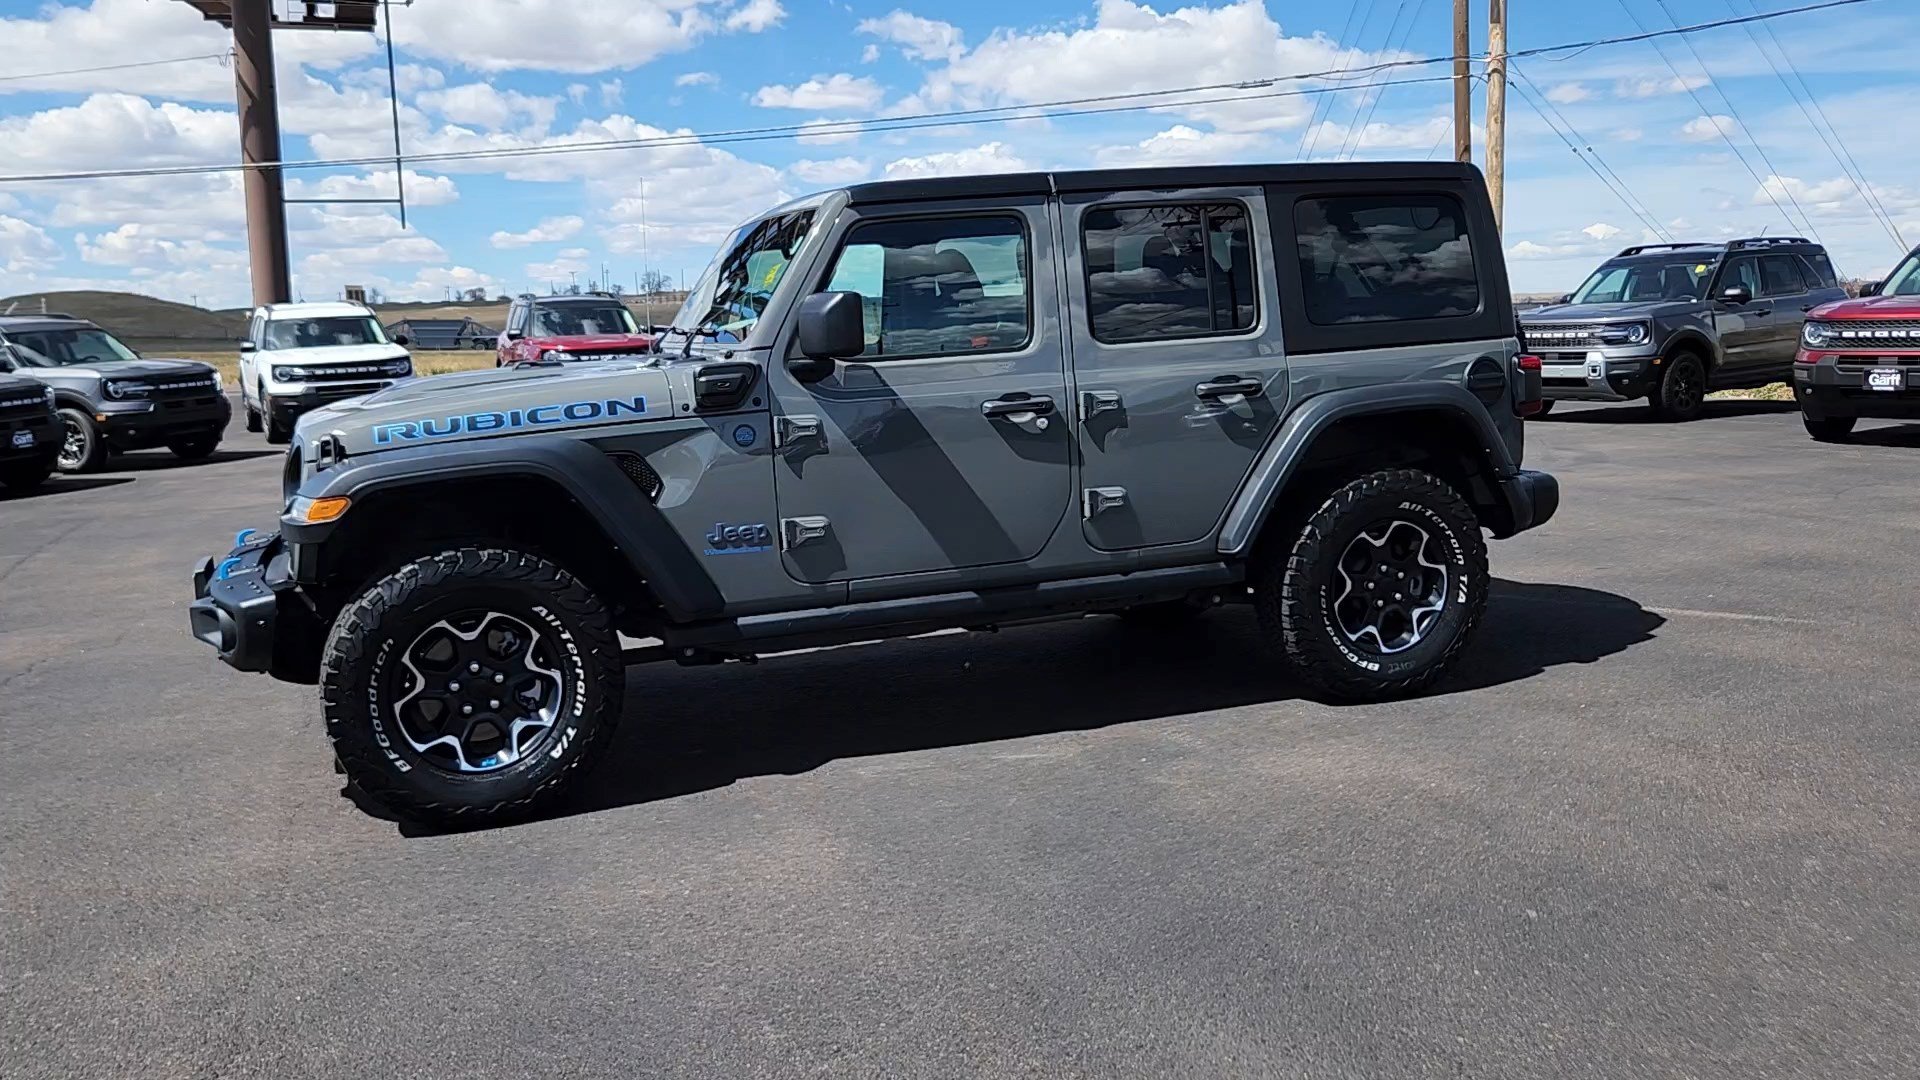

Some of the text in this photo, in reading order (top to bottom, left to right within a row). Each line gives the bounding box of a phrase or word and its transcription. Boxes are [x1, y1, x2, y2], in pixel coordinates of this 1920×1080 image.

[0, 397, 41, 407] ONCO
[1868, 373, 1901, 386] Garff
[373, 395, 647, 445] RUBICON
[706, 522, 768, 543] Jeep
[1398, 501, 1468, 603] All-Terrain T/A
[1320, 584, 1380, 671] BFGoodrich
[368, 638, 412, 772] BFGoodrich
[532, 605, 586, 759] All-Terrain T/A
